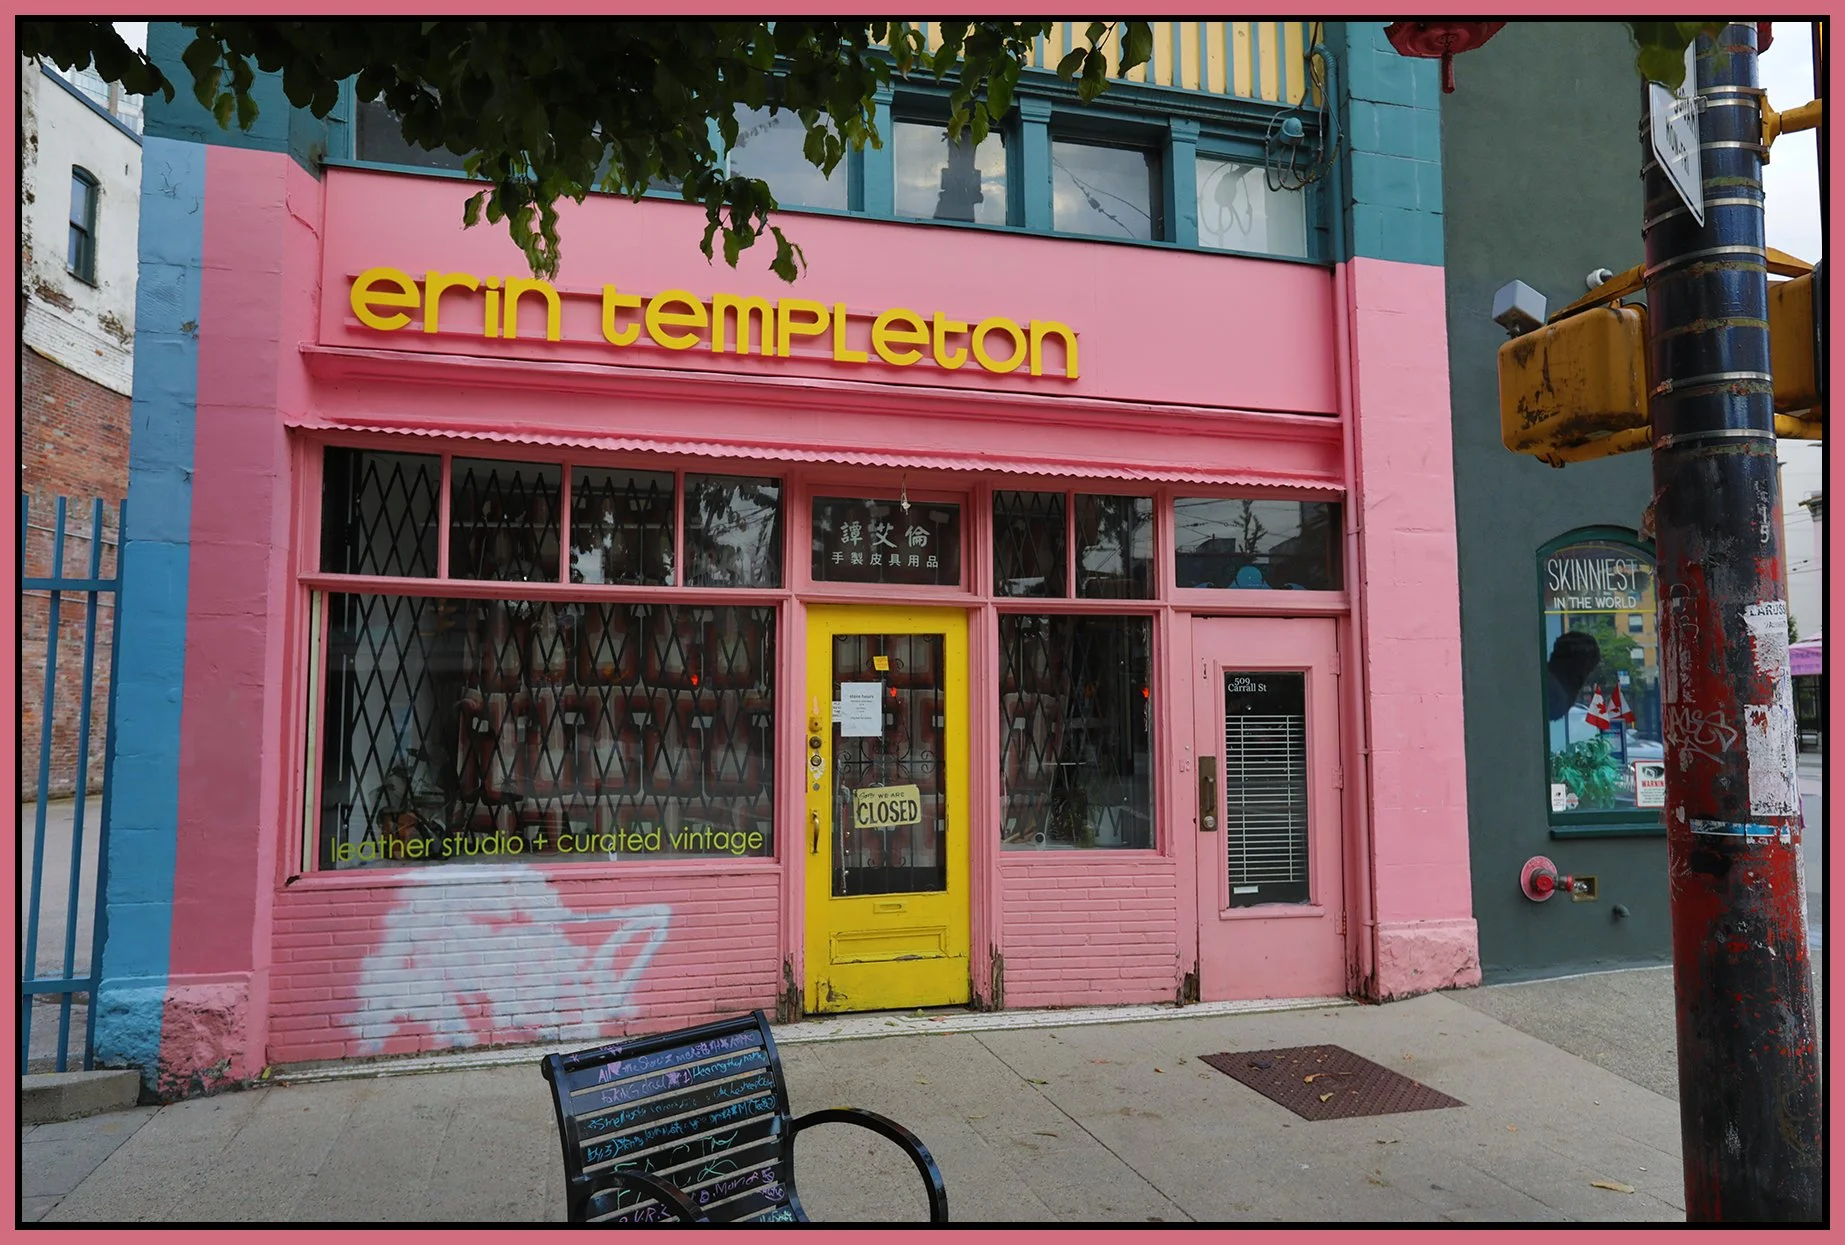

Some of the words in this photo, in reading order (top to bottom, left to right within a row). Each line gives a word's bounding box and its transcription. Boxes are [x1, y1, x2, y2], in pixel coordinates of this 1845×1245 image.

[350, 267, 561, 342] erin
[840, 520, 931, 549] 譚艾倫
[831, 551, 939, 568] 手製皮具用品
[1547, 558, 1638, 592] SKINNIEST
[1553, 597, 1566, 609] IN
[1568, 597, 1592, 609] THE
[1595, 596, 1637, 609] WORLD
[1227, 682, 1257, 693] Carrall
[1257, 683, 1267, 692] St
[1234, 677, 1251, 686] 509
[1641, 780, 1665, 788] WARNIN
[857, 799, 918, 825] CLOSED
[331, 833, 435, 863] leather
[442, 830, 524, 857] studio
[556, 826, 661, 853] curated
[669, 825, 763, 855] vintage
